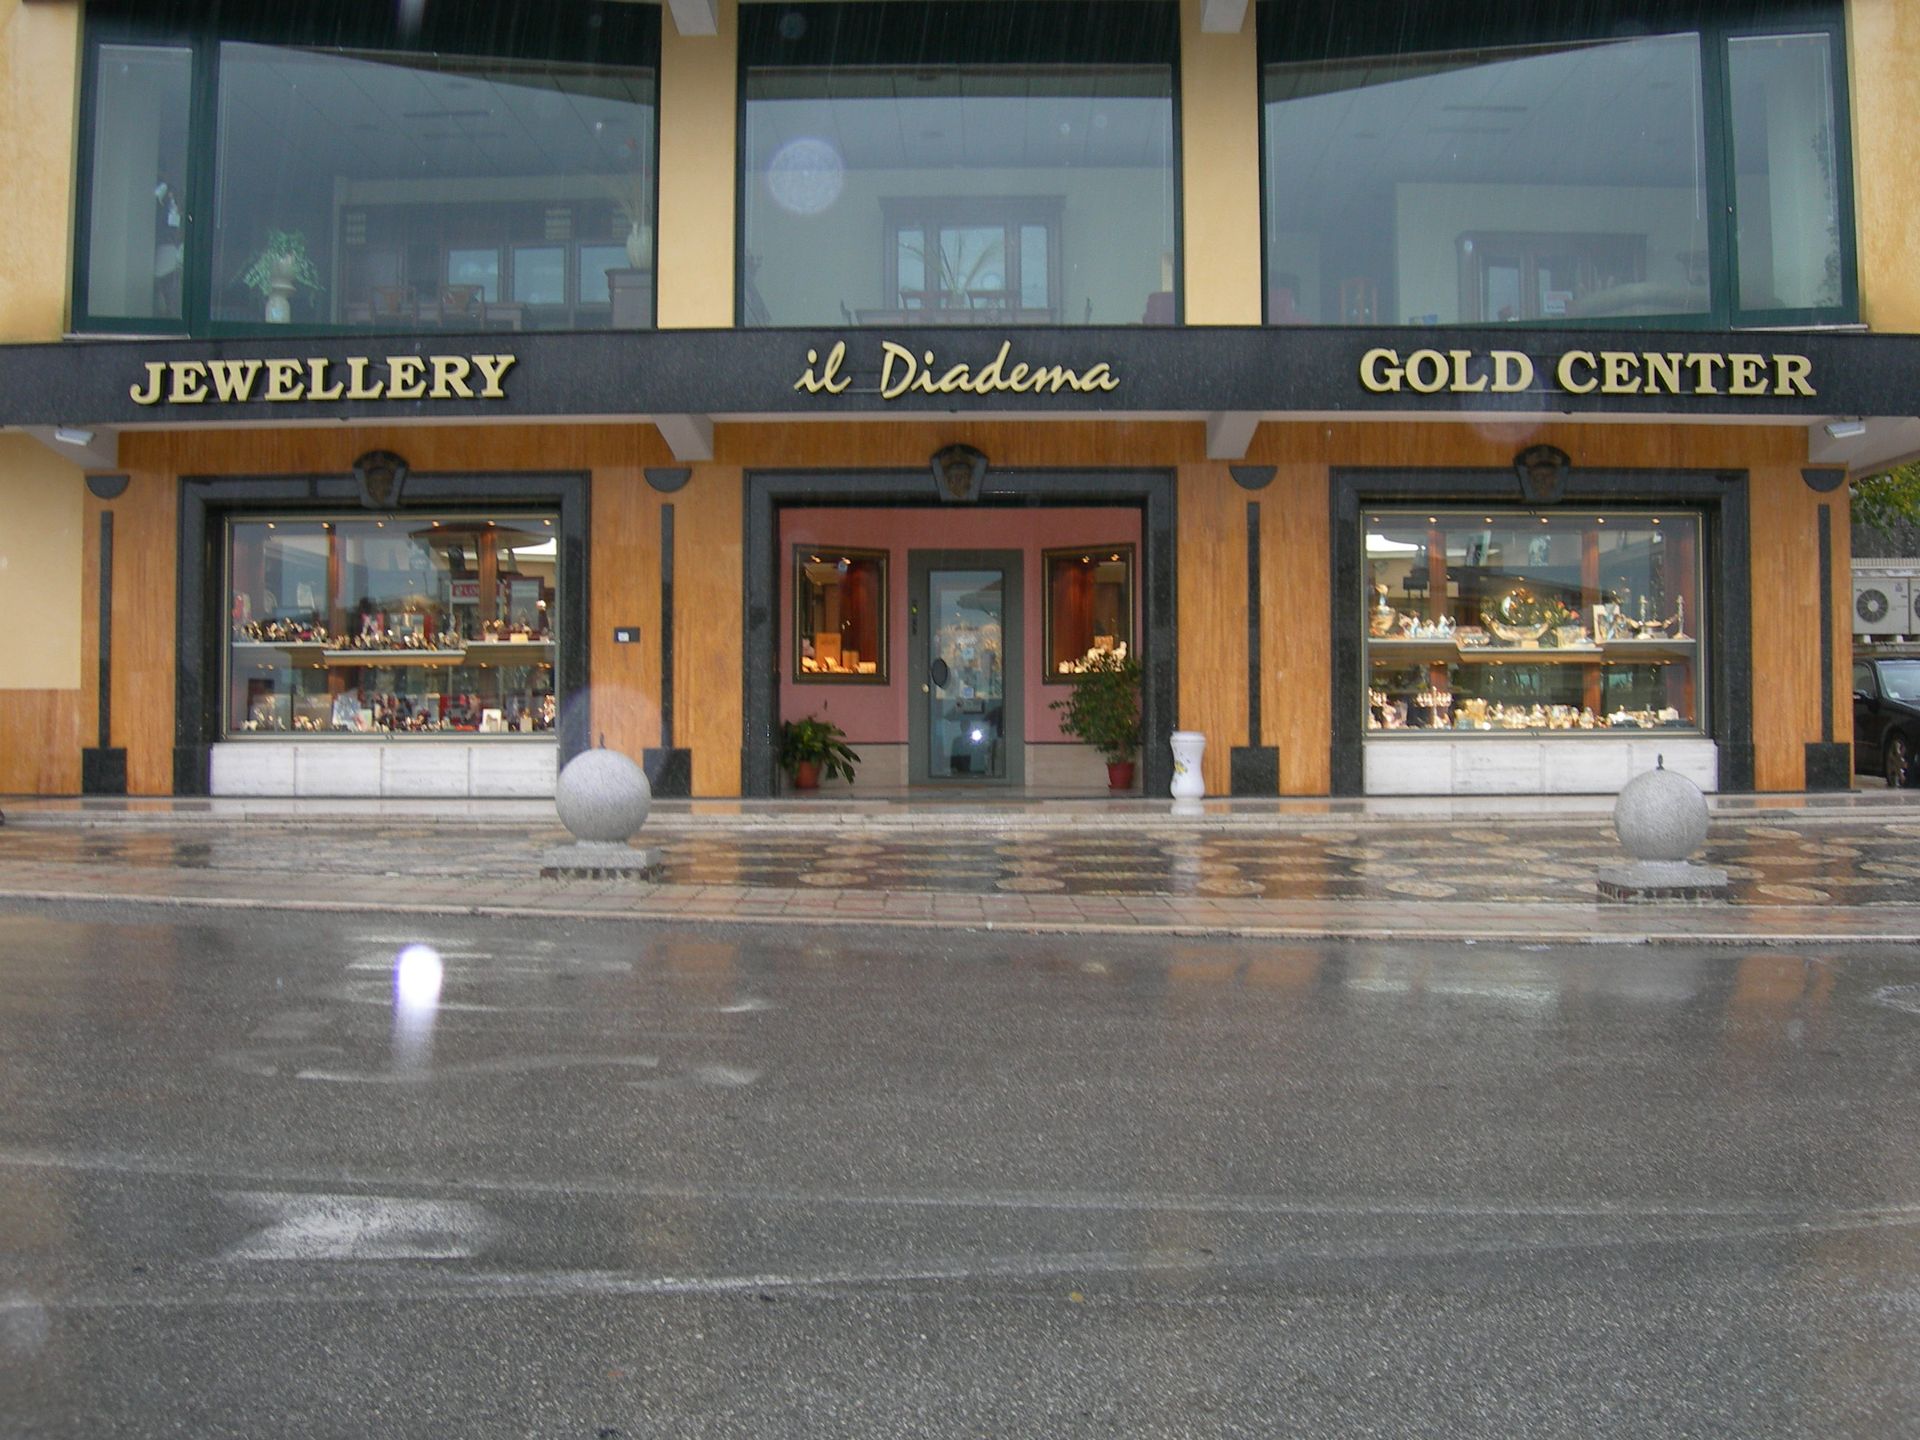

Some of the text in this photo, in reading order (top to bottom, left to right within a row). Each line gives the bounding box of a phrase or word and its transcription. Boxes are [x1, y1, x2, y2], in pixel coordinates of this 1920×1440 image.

[129, 354, 517, 405] JEWELLERY
[793, 341, 1120, 400] il Diadema
[1359, 348, 1817, 396] GOLD CENTER
